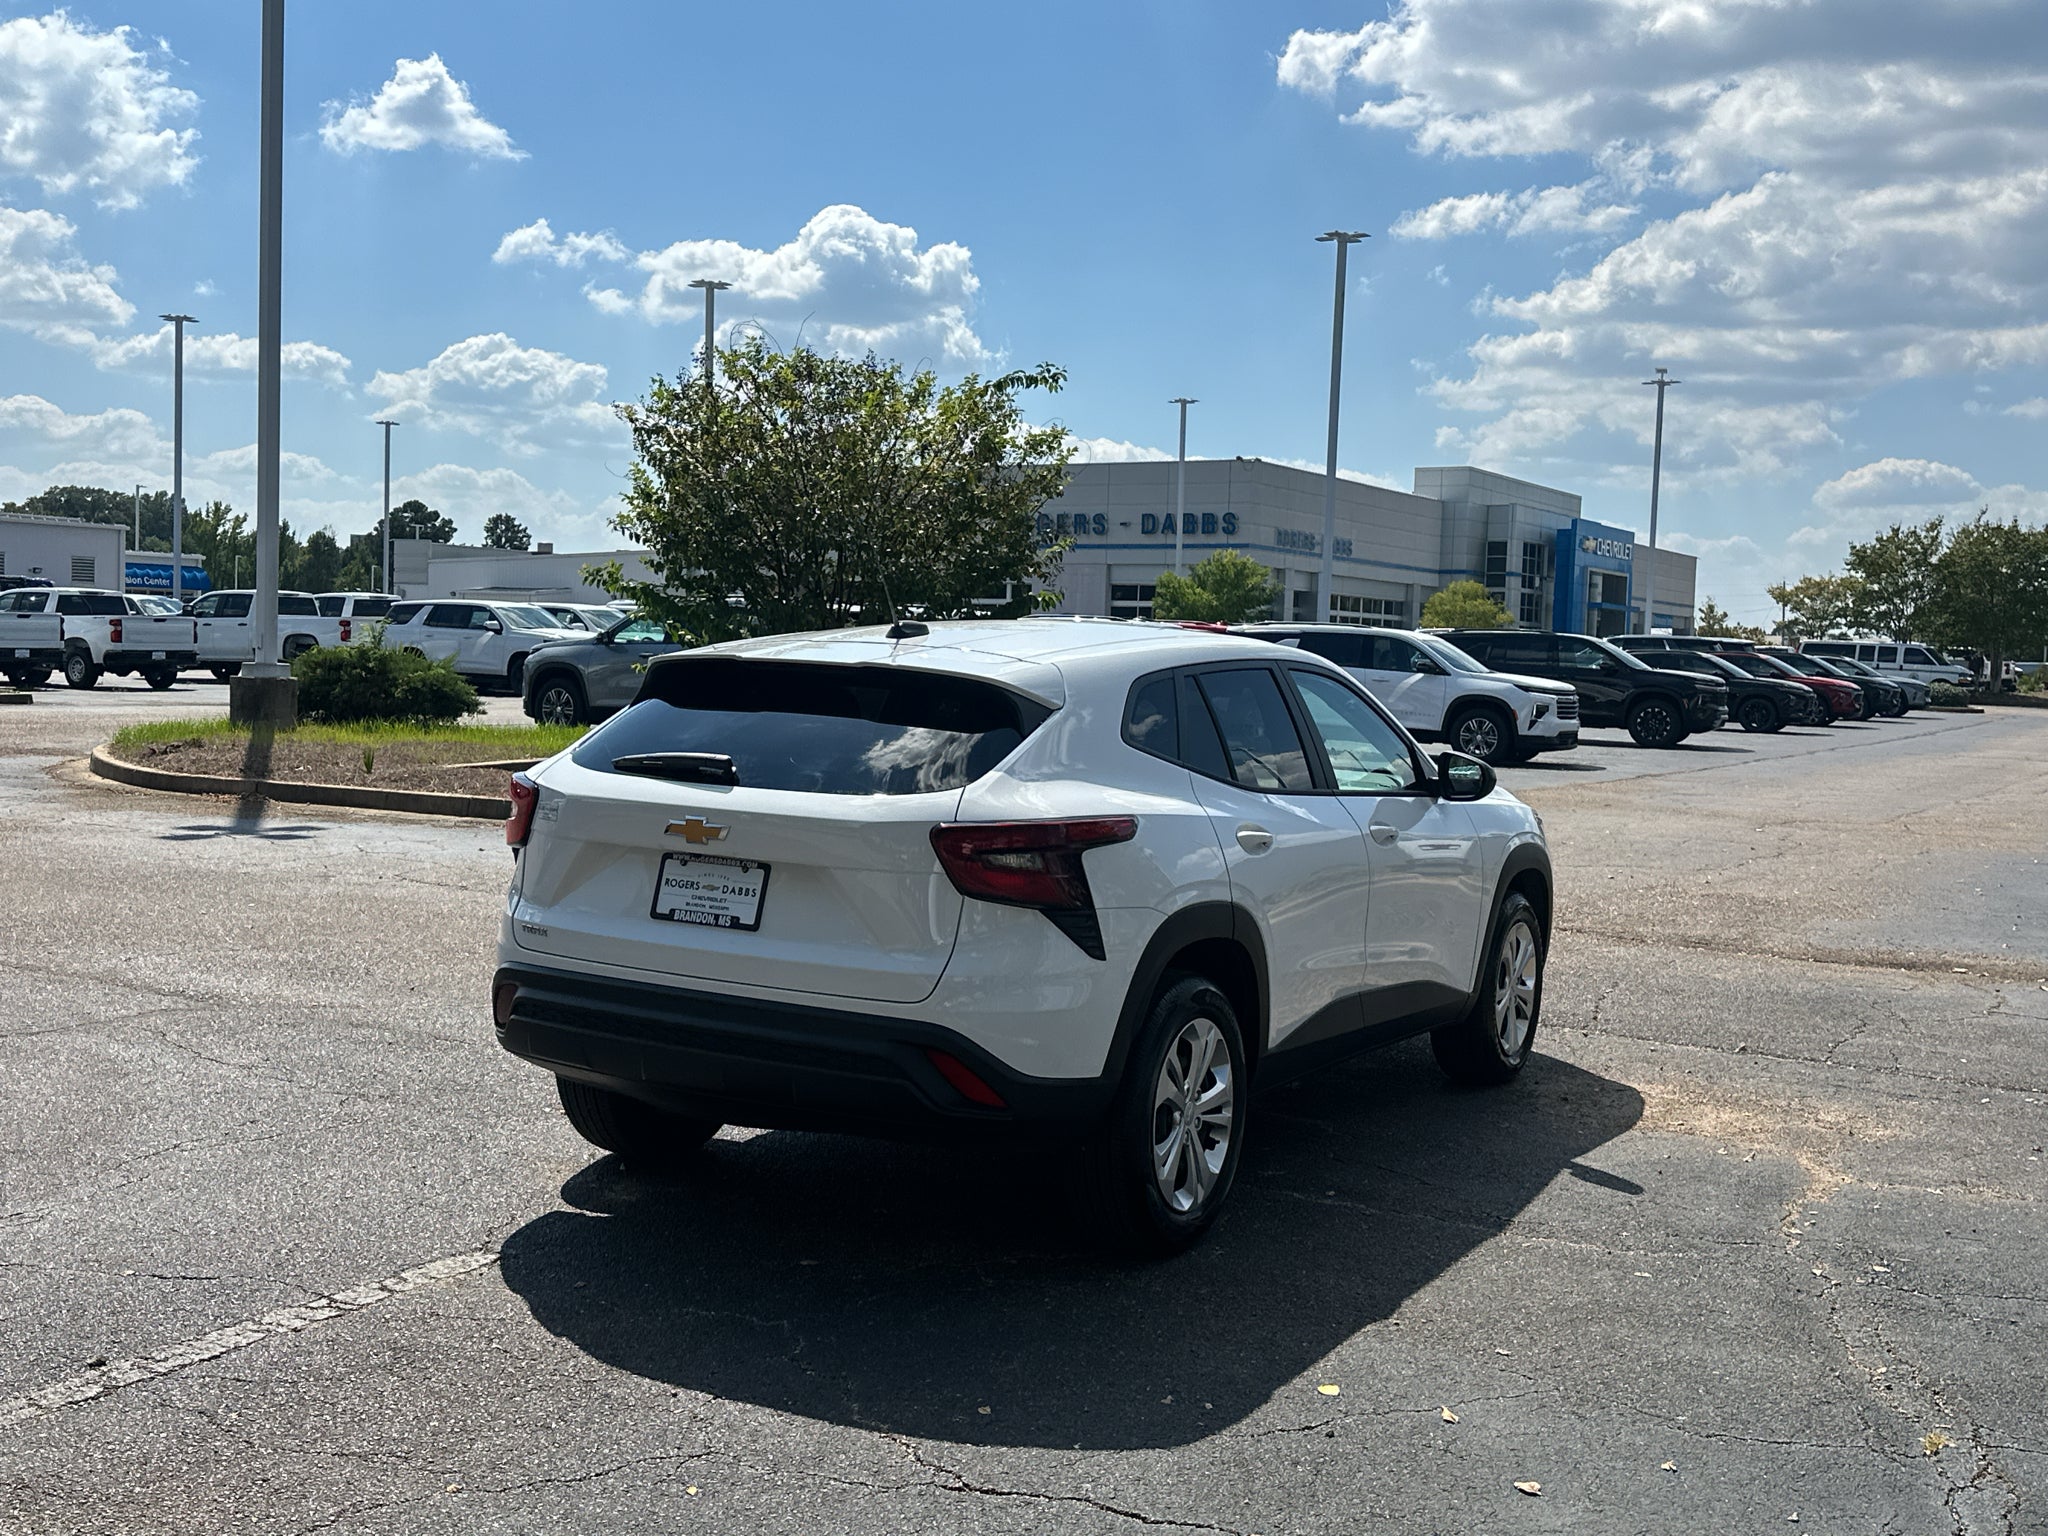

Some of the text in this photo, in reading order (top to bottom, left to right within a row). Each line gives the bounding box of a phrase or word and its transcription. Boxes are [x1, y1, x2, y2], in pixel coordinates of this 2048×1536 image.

[1035, 512, 1109, 536] GERS
[1141, 512, 1239, 536] DABBS
[1596, 538, 1633, 560] CHEVROLET
[143, 576, 170, 586] Center
[664, 878, 757, 897] ROGERS DABBS
[673, 909, 732, 926] BRANDON, MS
